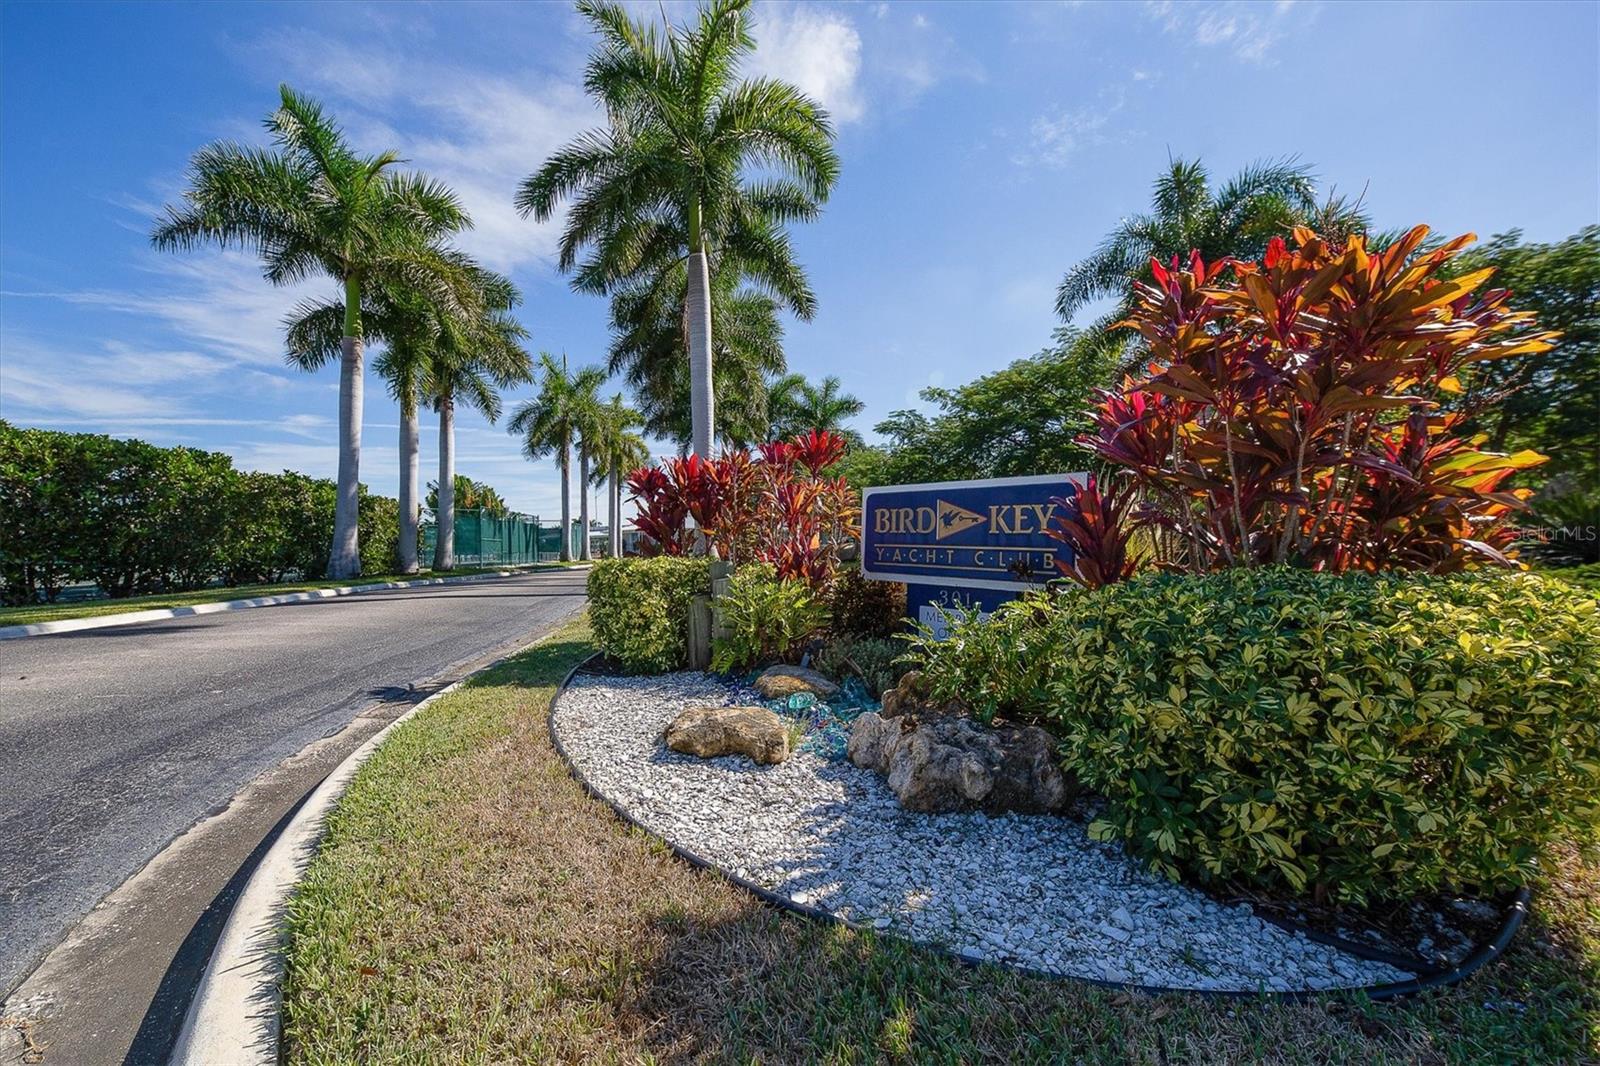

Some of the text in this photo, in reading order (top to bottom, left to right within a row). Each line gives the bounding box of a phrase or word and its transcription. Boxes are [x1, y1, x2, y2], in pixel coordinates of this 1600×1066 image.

[874, 504, 1057, 534] BIRD KEY
[939, 590, 971, 609] 301
